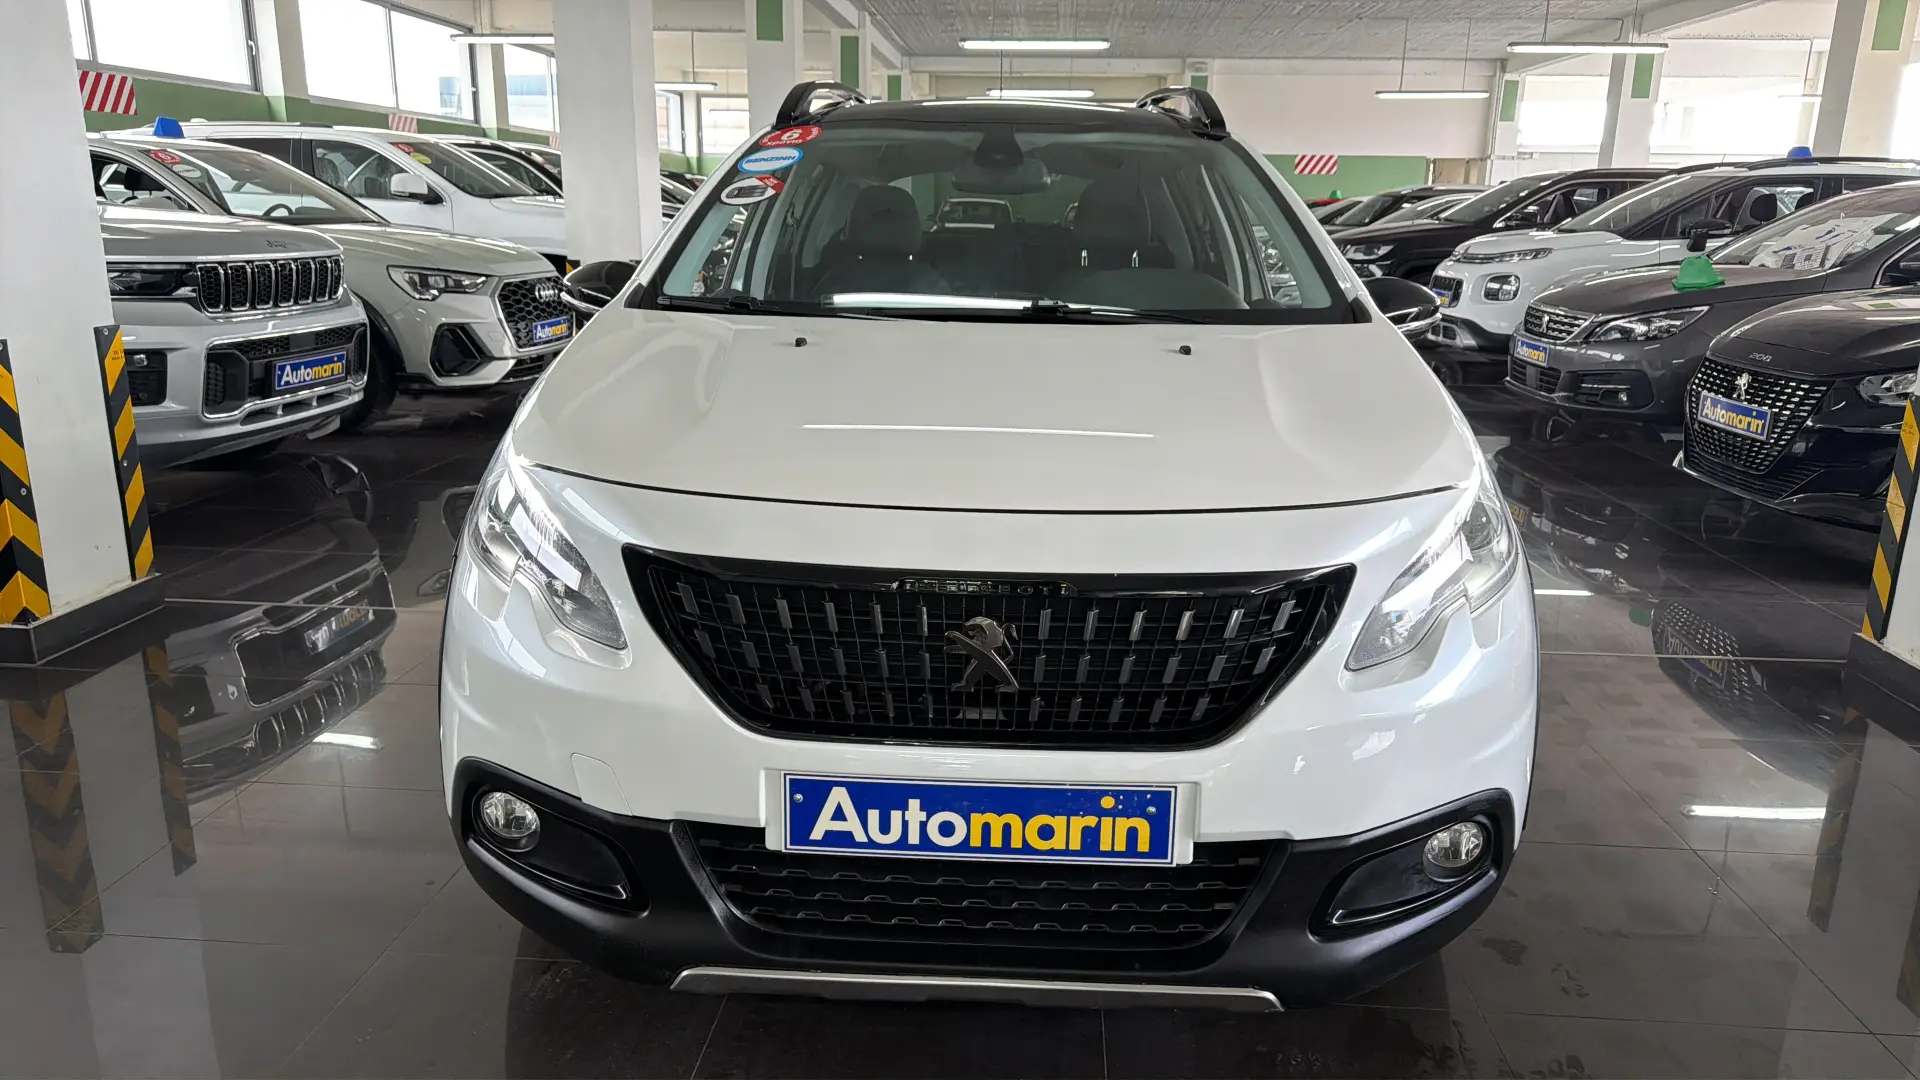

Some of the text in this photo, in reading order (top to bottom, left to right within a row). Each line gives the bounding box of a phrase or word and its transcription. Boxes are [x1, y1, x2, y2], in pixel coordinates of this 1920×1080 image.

[781, 129, 803, 141] 6
[536, 320, 567, 340] Automarin
[1516, 339, 1545, 362] Automarin
[281, 356, 342, 386] Automarin
[1702, 398, 1764, 434] Automarin
[808, 786, 1151, 853] Automarin
